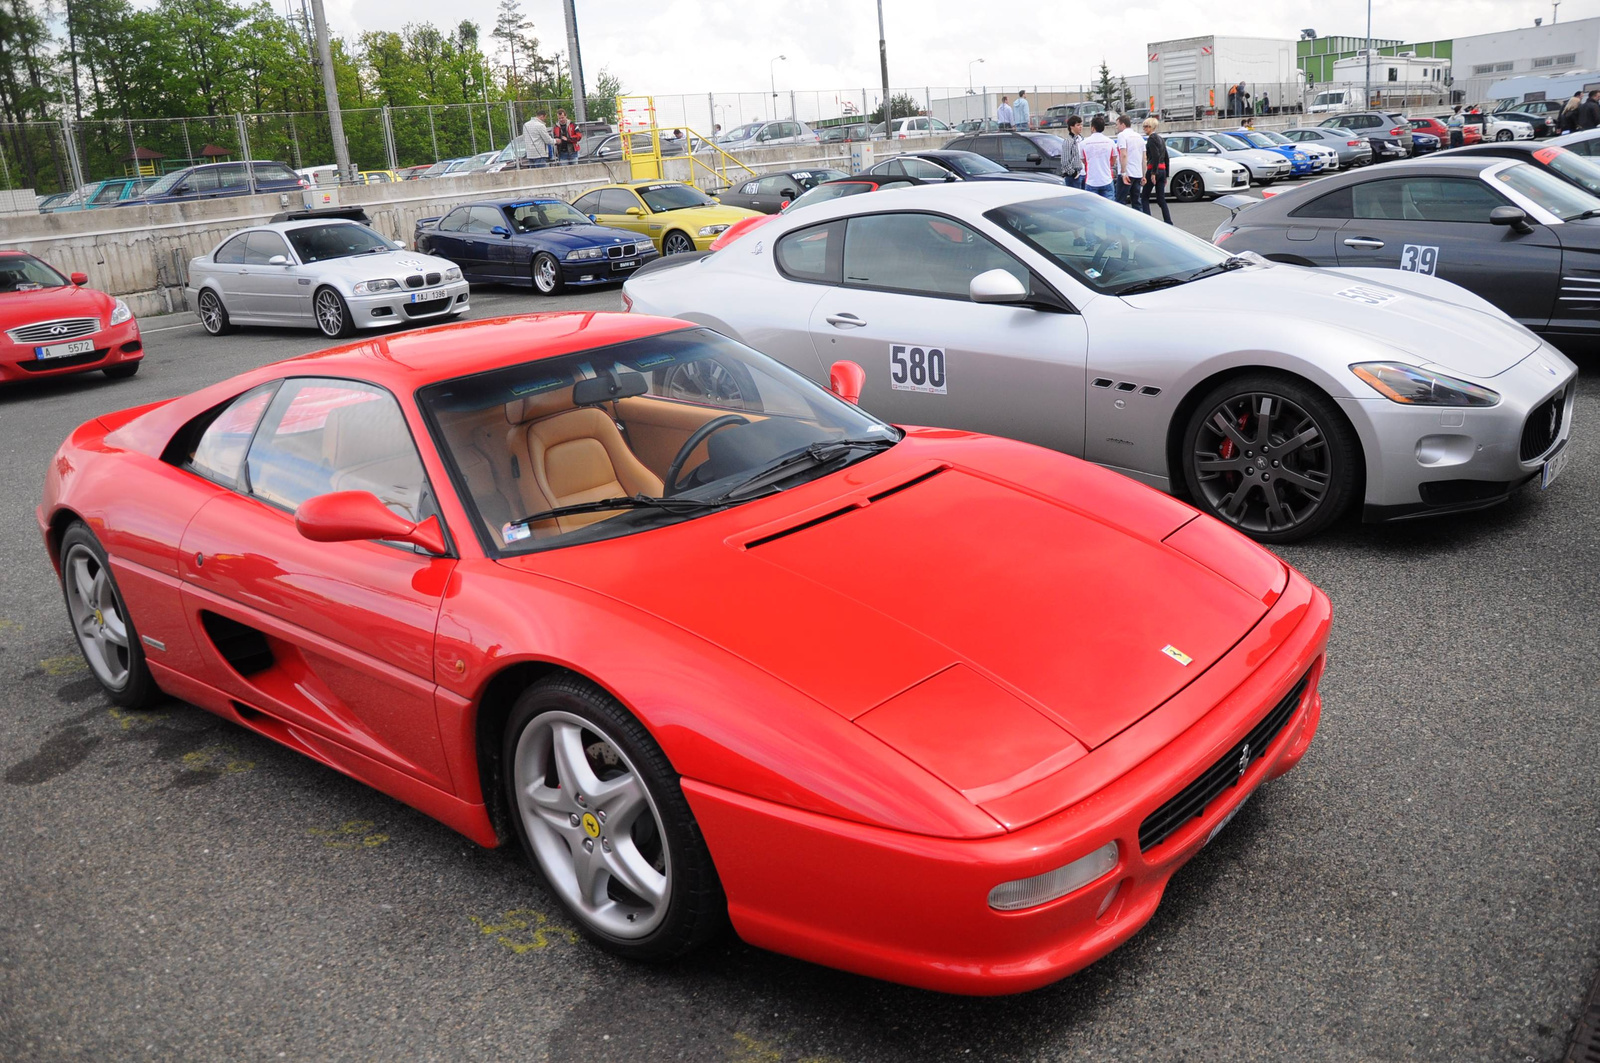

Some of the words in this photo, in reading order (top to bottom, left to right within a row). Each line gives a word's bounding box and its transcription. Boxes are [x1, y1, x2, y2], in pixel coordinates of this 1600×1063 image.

[1402, 246, 1436, 275] 39
[417, 293, 428, 301] 1AJ
[432, 290, 446, 299] 1396
[45, 348, 51, 357] A
[68, 341, 90, 353] 5572
[892, 346, 945, 388] 580
